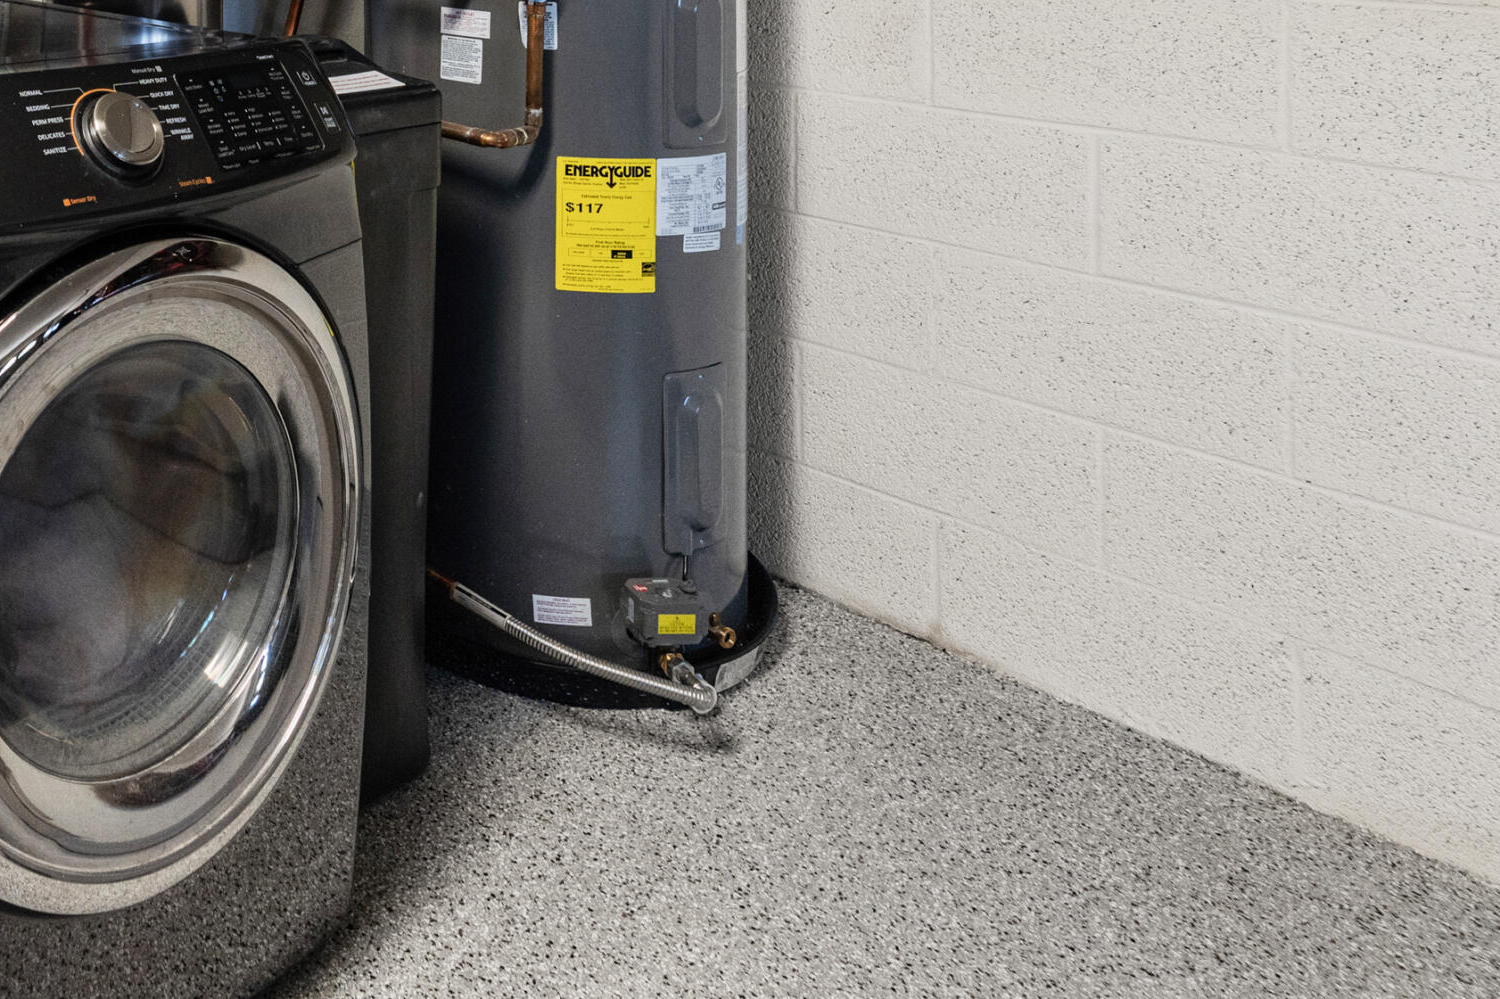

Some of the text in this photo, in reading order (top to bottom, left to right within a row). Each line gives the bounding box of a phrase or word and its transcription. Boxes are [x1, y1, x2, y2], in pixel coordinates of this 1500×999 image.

[18, 90, 43, 98] NORMAL
[25, 103, 51, 112] BEDDING
[47, 116, 64, 124] PRESS
[37, 131, 66, 141] DELICATES
[42, 146, 68, 156] SANITIZE
[564, 164, 652, 180] ENERGYGUIDE
[565, 202, 603, 214] $117
